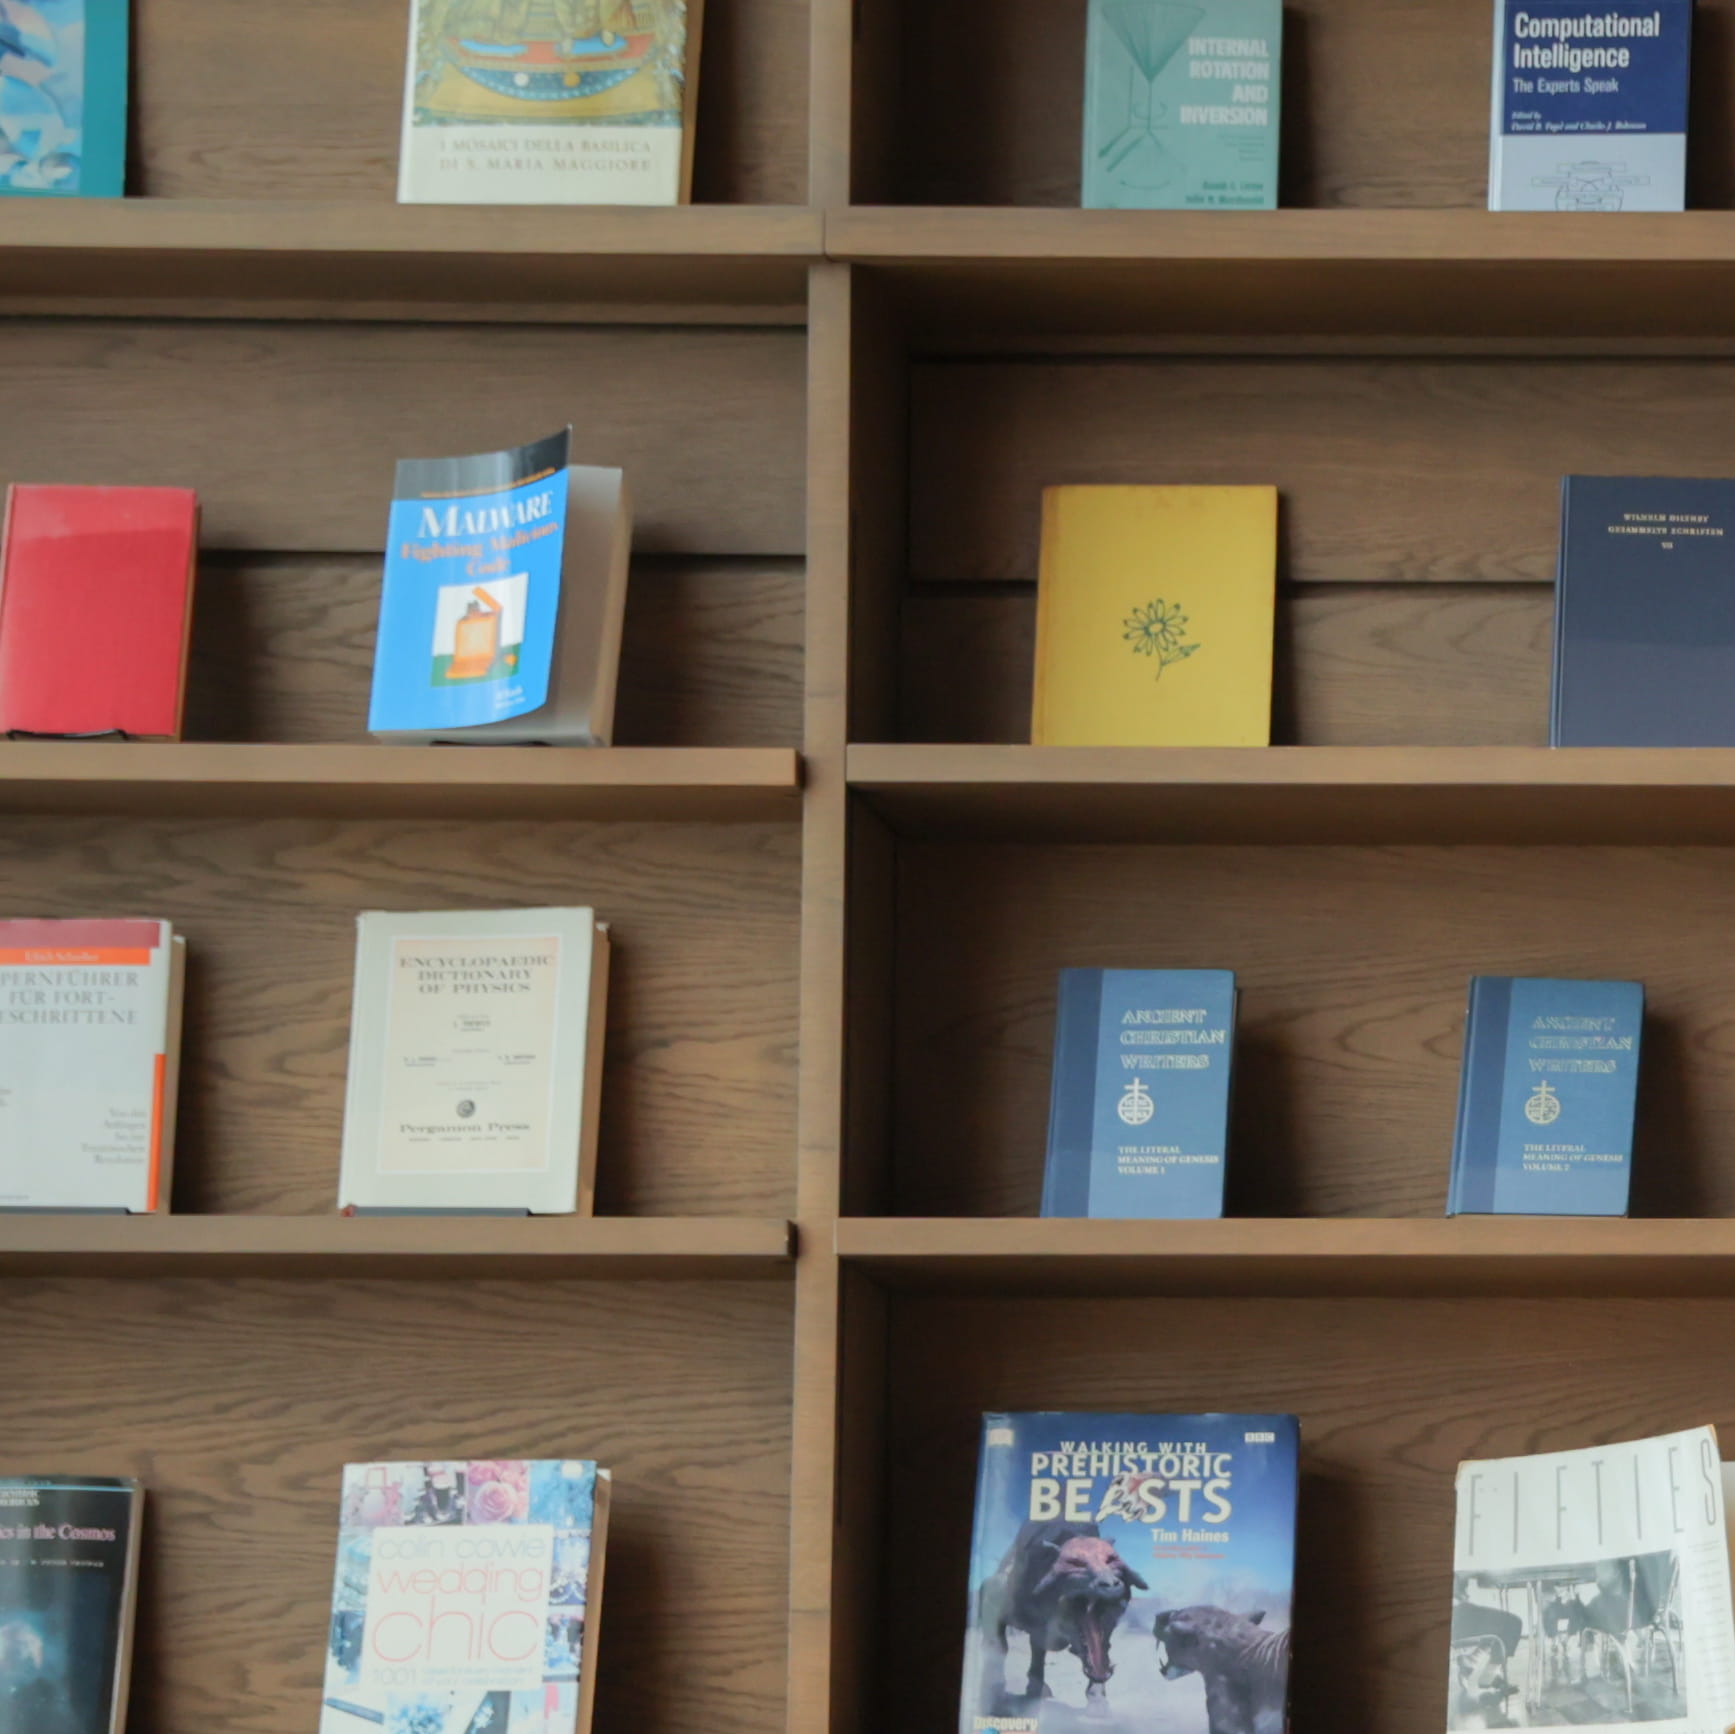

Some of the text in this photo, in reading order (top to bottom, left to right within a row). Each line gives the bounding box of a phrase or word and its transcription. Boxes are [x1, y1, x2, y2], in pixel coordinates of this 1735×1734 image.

[1514, 12, 1661, 42] Computational
[1188, 37, 1269, 57] INTERNAL
[1513, 43, 1630, 72] Intelligence
[1189, 60, 1270, 80] ROTATION
[1231, 85, 1269, 103] AND
[1513, 77, 1619, 95] The Experts Speak
[1179, 105, 1268, 126] INVERSION
[416, 491, 554, 538] MALWARE
[400, 956, 555, 968] ENCYCLOPAEDIC
[417, 969, 531, 981] DICTIONARY
[419, 982, 531, 995] OF PHYSICS
[1121, 1009, 1207, 1024] ANCIENT
[1120, 1030, 1225, 1045] CHRISTIAN
[1120, 1054, 1210, 1069] WRITERS
[400, 1121, 530, 1135] Pergamon Press
[1118, 1155, 1164, 1164] MEANING
[1179, 1155, 1219, 1164] GENESIS
[1060, 1441, 1207, 1455] WALKING WITH
[1030, 1452, 1232, 1478] PREHISTORIC
[1028, 1477, 1232, 1524] BEASTS
[1467, 1438, 1717, 1556] FIFTIES
[58, 1522, 116, 1541] Cosmos
[1151, 1528, 1229, 1543] Tim Haines
[454, 1532, 546, 1559] cowie
[376, 1560, 545, 1603] wedding
[372, 1594, 539, 1663] chic
